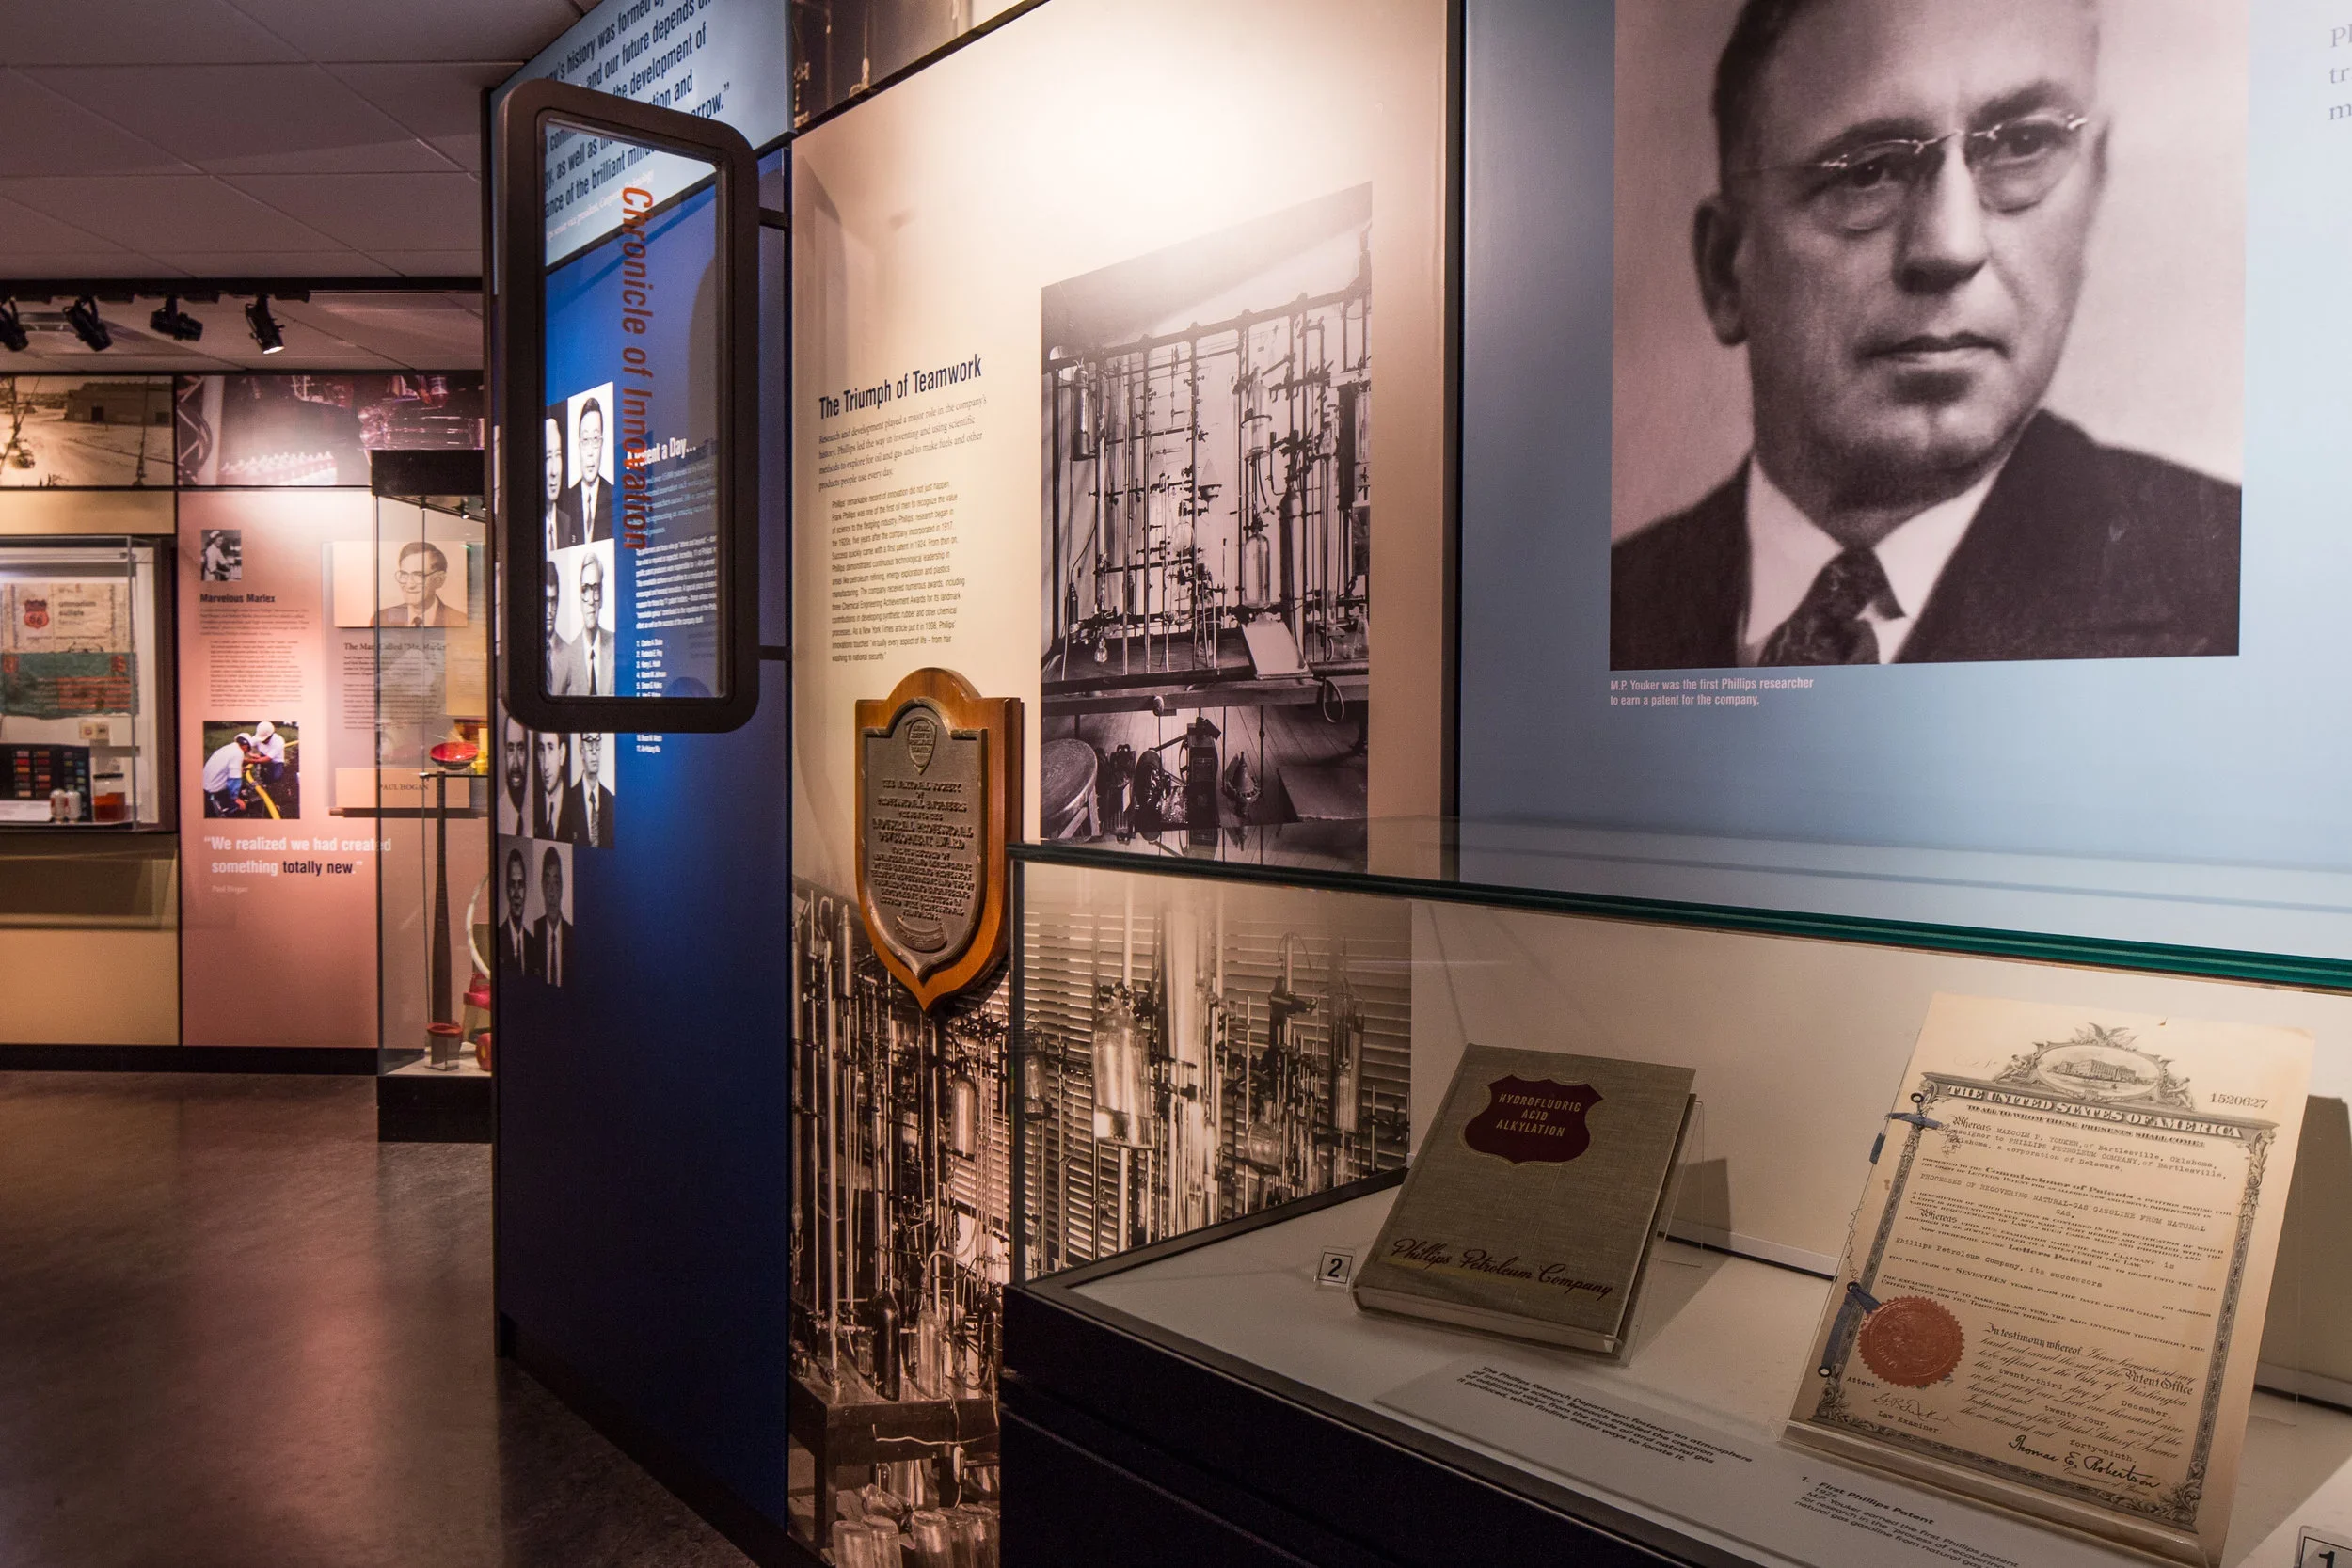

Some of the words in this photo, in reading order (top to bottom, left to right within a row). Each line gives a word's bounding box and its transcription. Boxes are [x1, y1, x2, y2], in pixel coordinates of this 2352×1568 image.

[567, 39, 596, 74] history
[598, 23, 615, 49] was
[617, 0, 650, 34] formed
[586, 62, 602, 88] and
[604, 54, 619, 78] our
[622, 32, 649, 66] future
[653, 1, 694, 43] depends
[630, 32, 692, 95] development
[696, 21, 707, 49] of
[675, 69, 692, 101] and
[557, 160, 565, 180] as
[568, 142, 585, 170] well
[588, 138, 597, 159] as
[565, 182, 574, 206] of
[576, 178, 589, 199] the
[592, 150, 625, 189] brilliant
[622, 187, 654, 335] Chronicle
[622, 346, 653, 379] of
[819, 396, 839, 420] The
[843, 379, 891, 413] Triumph
[896, 372, 908, 399] of
[913, 353, 981, 394] Teamwork
[851, 421, 883, 436] development
[926, 405, 937, 418] role
[945, 403, 954, 413] the
[661, 443, 668, 460] a
[622, 388, 653, 549] Innovation
[199, 594, 244, 603] Marvelous
[246, 594, 276, 603] Marlex
[1610, 680, 1628, 690] M.P.
[1630, 680, 1659, 690] Youker
[1662, 682, 1679, 690] was
[1683, 679, 1696, 690] the
[1700, 679, 1718, 689] first
[1722, 677, 1756, 691] Phillips
[1759, 677, 1814, 689] researcher
[1610, 695, 1618, 705] to
[1651, 695, 1679, 707] patent
[1681, 694, 1694, 705] for
[1697, 694, 1711, 705] the
[1714, 695, 1759, 706] company.
[235, 837, 287, 851] realized
[291, 840, 310, 851] we
[313, 837, 337, 851] had
[212, 860, 278, 876] something
[282, 860, 323, 876] totally
[1498, 1093, 1581, 1112] HYDROFLUORIC
[1520, 1109, 1549, 1121] ACID
[1947, 1085, 1985, 1101] THE
[1986, 1090, 2055, 1112] UNITED
[2056, 1101, 2124, 1124] STATES
[2125, 1113, 2153, 1127] OF
[2153, 1117, 2244, 1140] AMERICA
[2211, 1093, 2268, 1110] 1520627
[1496, 1119, 1565, 1137] ALKYLATION
[1979, 1184, 2029, 1199] RECOVERING
[2033, 1195, 2089, 1212] NATURAL-GAS
[2093, 1206, 2136, 1219] GASOLINE
[2139, 1214, 2163, 1225] FROM
[2167, 1220, 2206, 1232] NATURAL
[2055, 1209, 2074, 1219] GAS.
[1327, 1258, 1343, 1278] 2
[1390, 1238, 1453, 1270] Phillips
[1459, 1248, 1533, 1279] Petroleum
[1538, 1263, 1613, 1301] Company
[2000, 1328, 2045, 1348] testimony
[1846, 1376, 1880, 1389] Attest:
[1998, 1368, 2063, 1390] twenty-third
[2122, 1367, 2161, 1388] Patent
[2160, 1377, 2194, 1396] Office
[1477, 1378, 1523, 1395] additional
[1523, 1394, 1547, 1403] value
[1548, 1402, 1570, 1413] from
[1573, 1411, 1589, 1419] the
[1590, 1418, 1617, 1429] crude
[1633, 1433, 1654, 1442] and
[1655, 1440, 1695, 1456] natural
[1694, 1454, 1715, 1464] gas
[1482, 1366, 1498, 1374] The
[1499, 1372, 1530, 1386] Phillips
[1531, 1384, 1571, 1400] Research
[1573, 1398, 1630, 1420] Department
[1631, 1418, 1674, 1434] fostered
[1690, 1439, 1753, 1463] atmosphere
[1484, 1374, 1530, 1391] innovative
[1567, 1402, 1609, 1419] Research
[1611, 1418, 1651, 1434] enabled
[1652, 1432, 1669, 1440] the
[1672, 1439, 1714, 1456] creation
[1510, 1396, 1534, 1406] while
[1535, 1404, 1568, 1420] finding
[1570, 1418, 1600, 1430] better
[1602, 1429, 1627, 1440] ways
[1641, 1442, 1673, 1456] locate
[1877, 1410, 1894, 1420] Law
[1897, 1416, 1943, 1435] Examiner.
[2044, 1405, 2109, 1429] twenty-four,
[2121, 1400, 2171, 1419] December,
[2083, 1455, 2161, 1488] Robertson
[1818, 1482, 1845, 1495] First
[1847, 1492, 1890, 1510] Phillips
[1892, 1507, 1934, 1525] Patent
[1793, 1500, 1830, 1515] natural
[1830, 1513, 1850, 1523] gas
[1850, 1520, 1893, 1537] gasoline
[1895, 1535, 1920, 1547] from
[1921, 1544, 1962, 1561] natural
[1816, 1501, 1857, 1518] research
[1870, 1520, 1888, 1528] the
[1948, 1547, 2006, 1568] recovering
[1830, 1498, 1862, 1513] Youker
[1863, 1511, 1899, 1526] earned
[1900, 1523, 1917, 1532] the
[1919, 1529, 1941, 1541] first
[1943, 1538, 1979, 1554] Phillips
[1980, 1552, 2019, 1568] patent
[2318, 1550, 2335, 1568] 1
